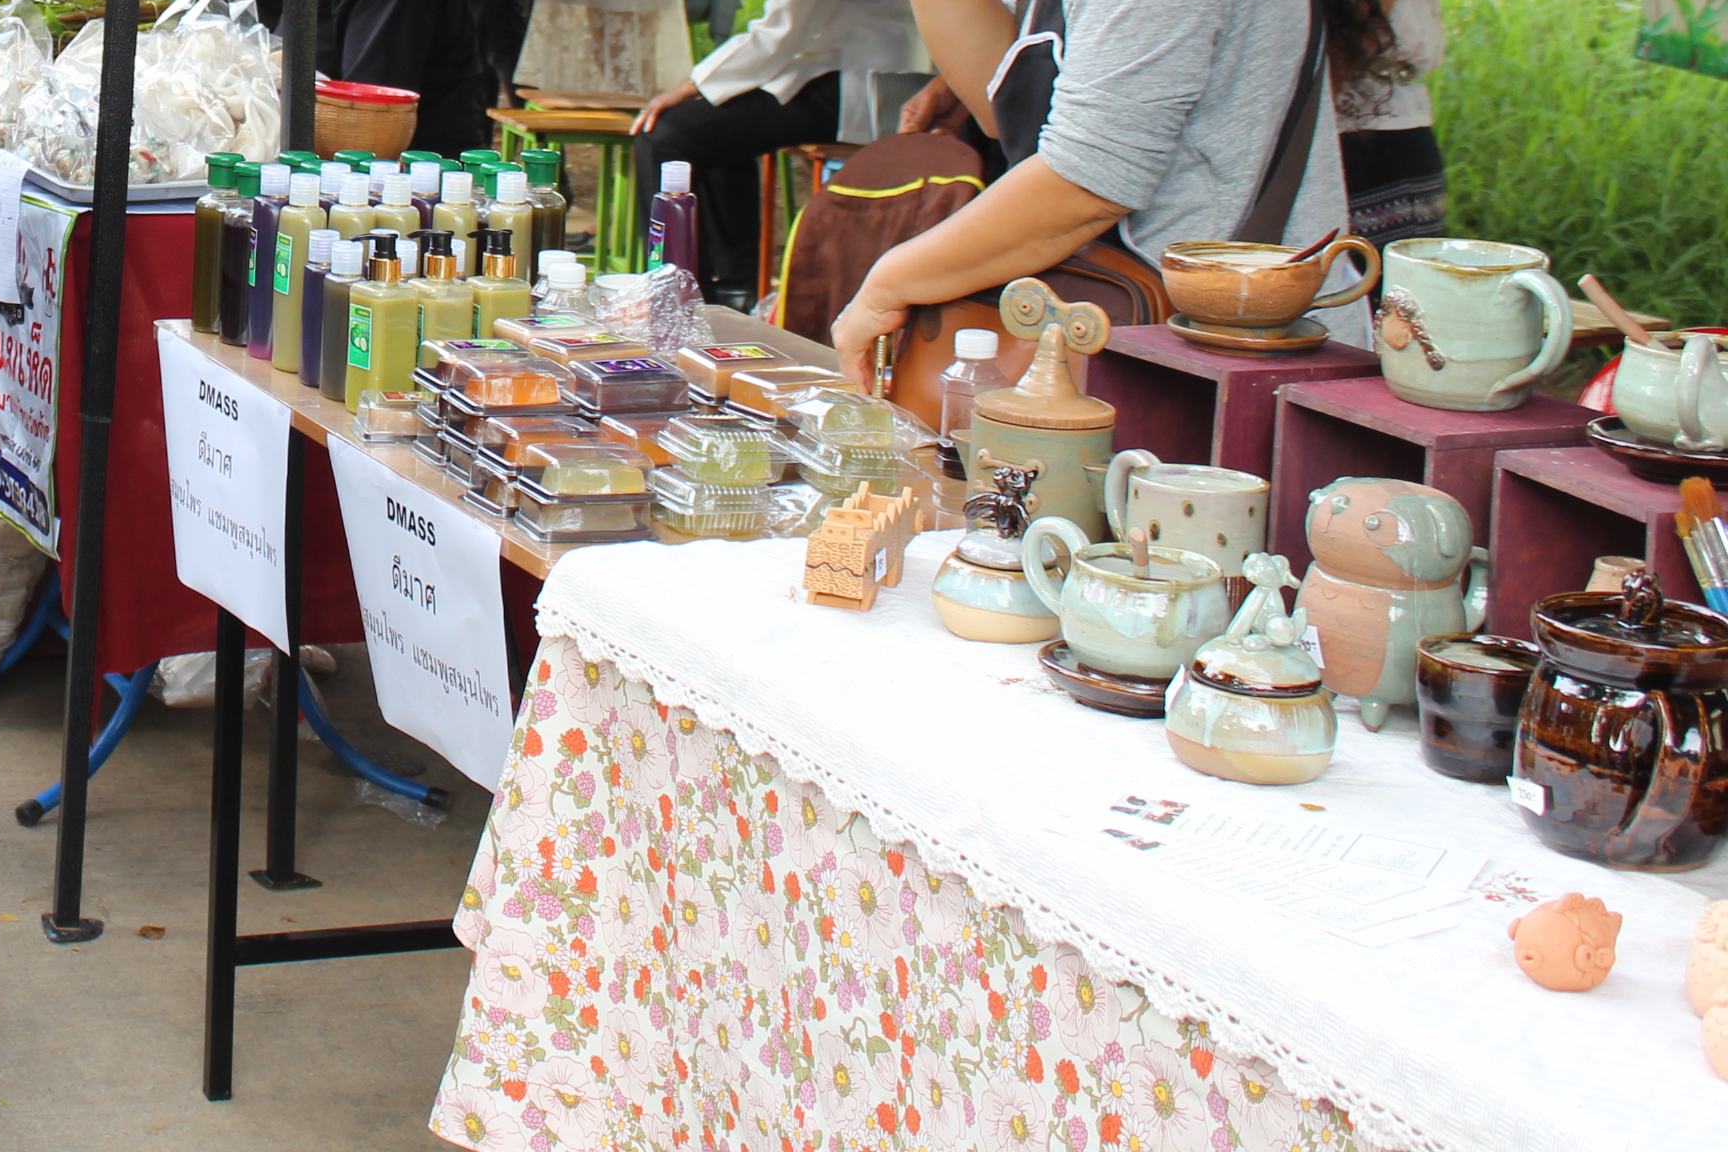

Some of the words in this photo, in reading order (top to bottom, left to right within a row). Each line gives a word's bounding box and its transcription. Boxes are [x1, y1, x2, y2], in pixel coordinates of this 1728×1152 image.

[198, 379, 239, 421] DMASS
[198, 431, 233, 479] ดีมาศ
[170, 478, 202, 518] สมุนไพร
[208, 506, 278, 567] แชมพูสมุนไพร
[386, 496, 436, 546] DMASS
[392, 554, 436, 615] ดีมาศ
[361, 605, 405, 655] สมุนไพร
[412, 643, 500, 718] แชมพูสมุนไพร
